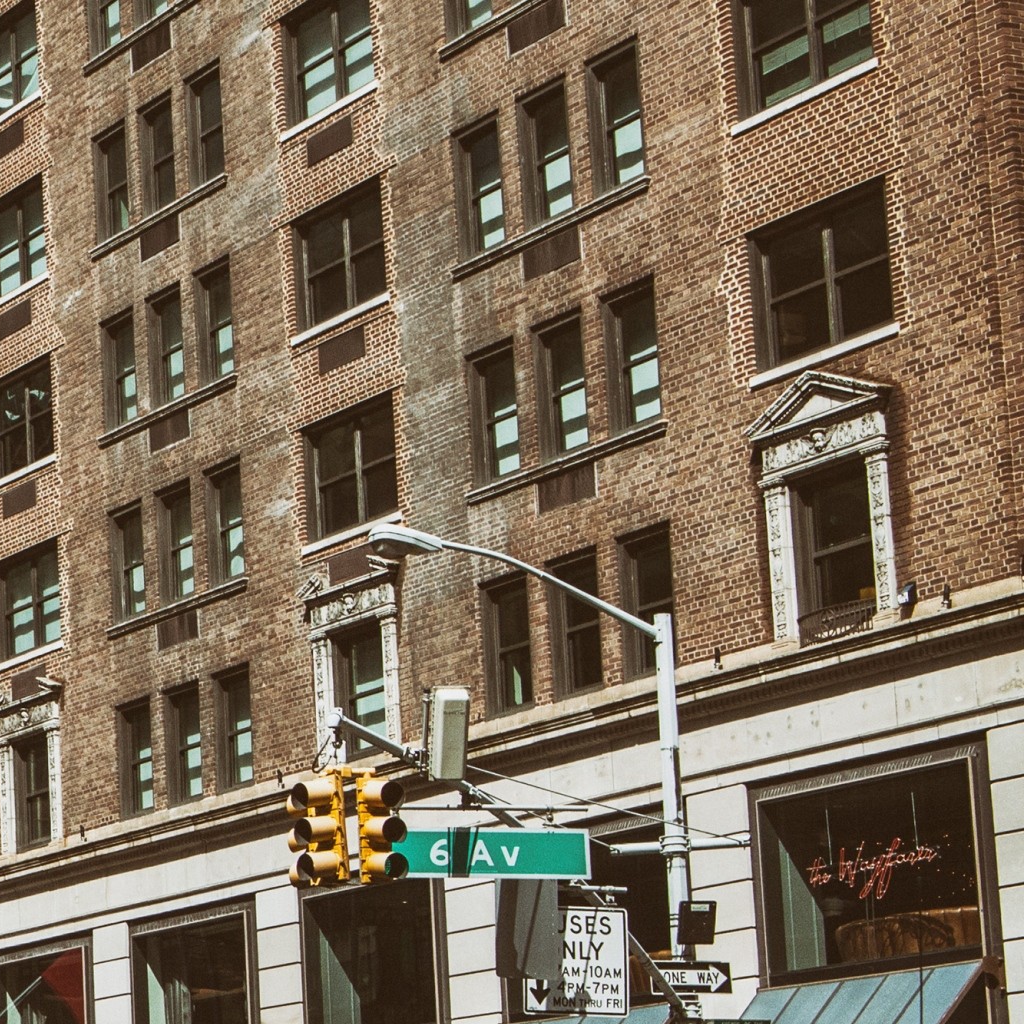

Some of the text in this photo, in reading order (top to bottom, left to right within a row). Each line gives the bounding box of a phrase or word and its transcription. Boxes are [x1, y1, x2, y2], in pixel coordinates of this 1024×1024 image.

[429, 839, 449, 866] 6
[563, 941, 604, 960] NLY
[560, 966, 622, 979] AM-10AM
[663, 971, 720, 985] ONE WAY
[557, 982, 619, 995] 4PM-7PM
[553, 996, 623, 1009] MON THRU FRI
